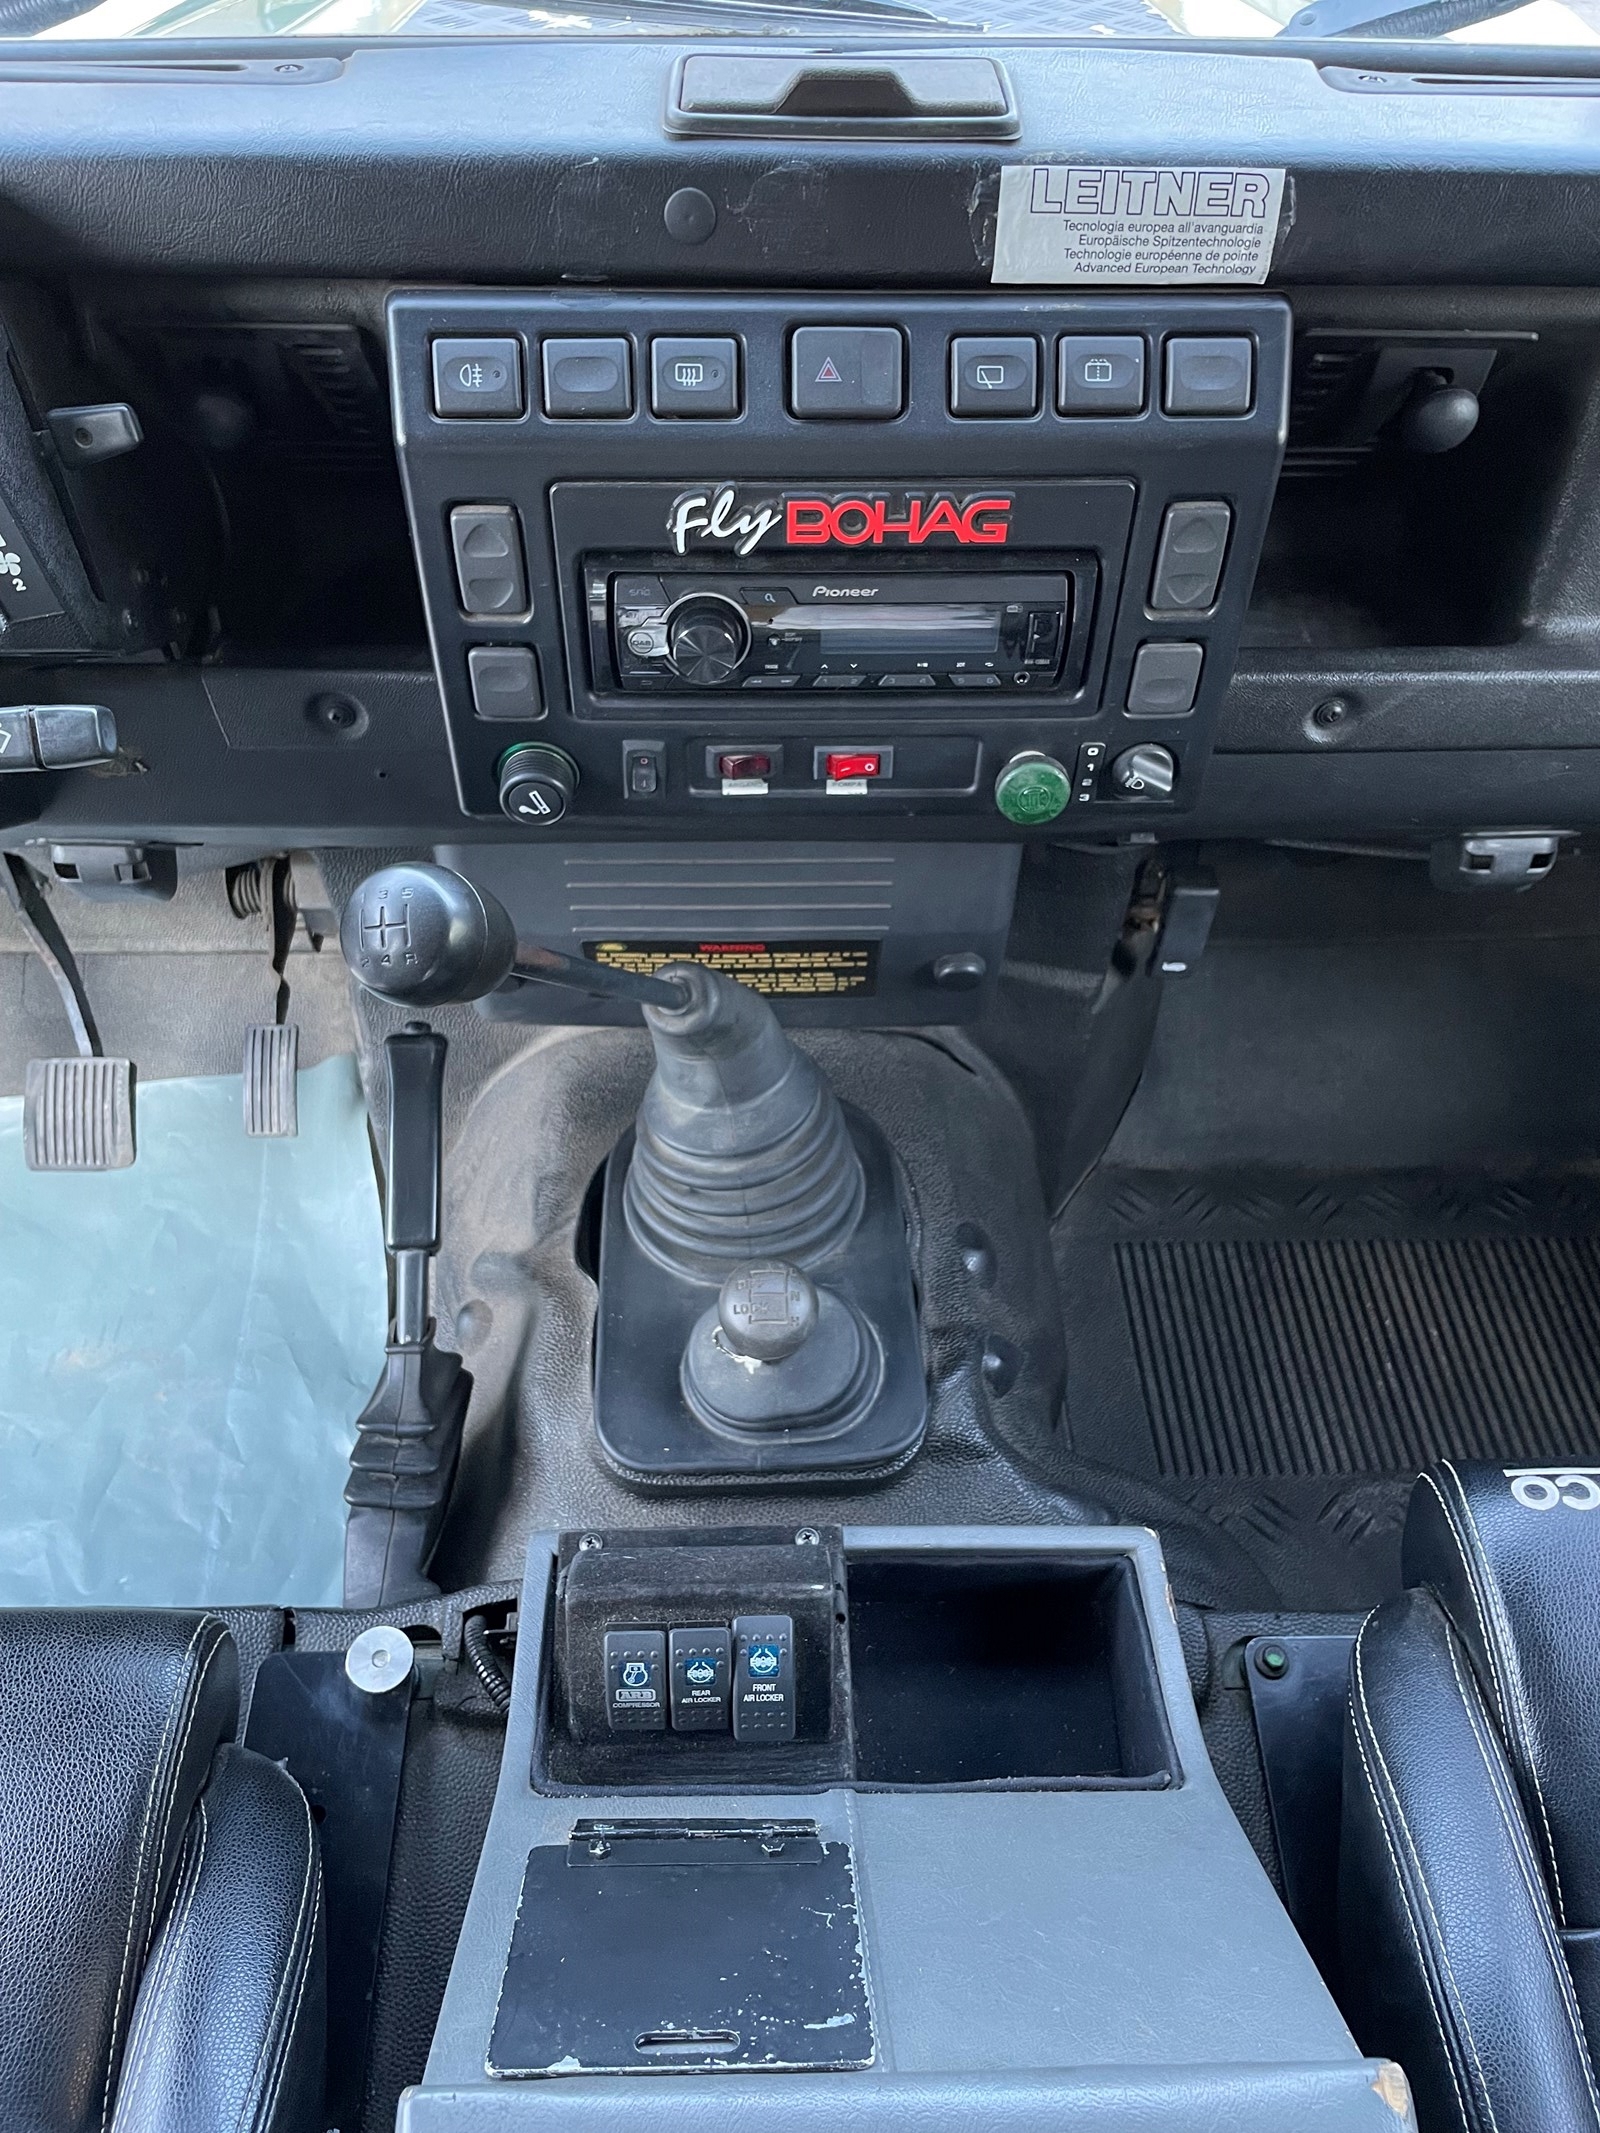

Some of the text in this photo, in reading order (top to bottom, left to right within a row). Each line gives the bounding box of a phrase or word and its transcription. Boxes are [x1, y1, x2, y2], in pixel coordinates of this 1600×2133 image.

[1030, 168, 1270, 218] LEITNER
[1063, 220, 1264, 236] Tecnologia europea all'avanguardia
[1079, 234, 1261, 249] Europäische Spitzentechnologie
[1064, 248, 1259, 263] Technologie européenne de pointe
[1073, 263, 1257, 276] Advanced European Technology
[670, 486, 1012, 555] Fly BOHAG
[12, 578, 27, 592] 2
[812, 585, 879, 597] Pioneer
[1087, 763, 1094, 772] 1
[1081, 778, 1093, 786] 2
[1079, 793, 1090, 802] 3
[378, 888, 389, 899] 3
[401, 887, 414, 899] 5
[361, 953, 419, 968] 2 4 R
[733, 1302, 770, 1315] LOCK
[752, 1683, 776, 1692] FRONT
[620, 1690, 653, 1700] ARB
[681, 1696, 693, 1704] AIR
[743, 1693, 784, 1702] AIR LOCKER
